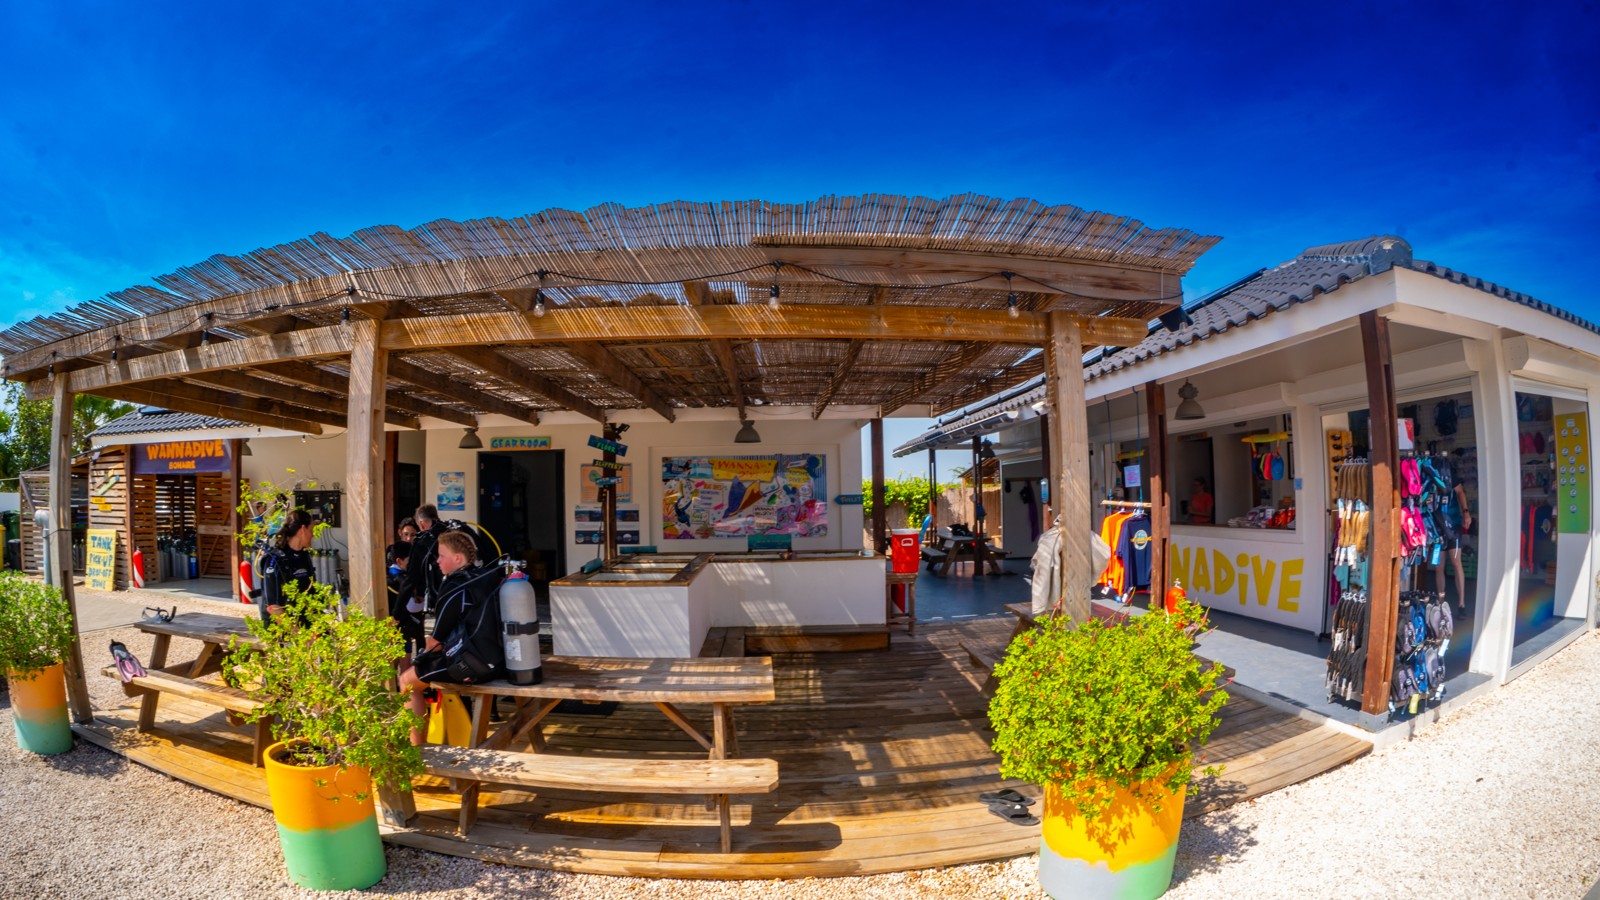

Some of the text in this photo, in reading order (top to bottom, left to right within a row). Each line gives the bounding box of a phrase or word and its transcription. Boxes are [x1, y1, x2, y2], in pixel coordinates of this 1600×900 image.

[146, 439, 225, 460] WANNADIVE
[594, 460, 623, 470] SLIPPERY
[91, 535, 113, 551] TANK
